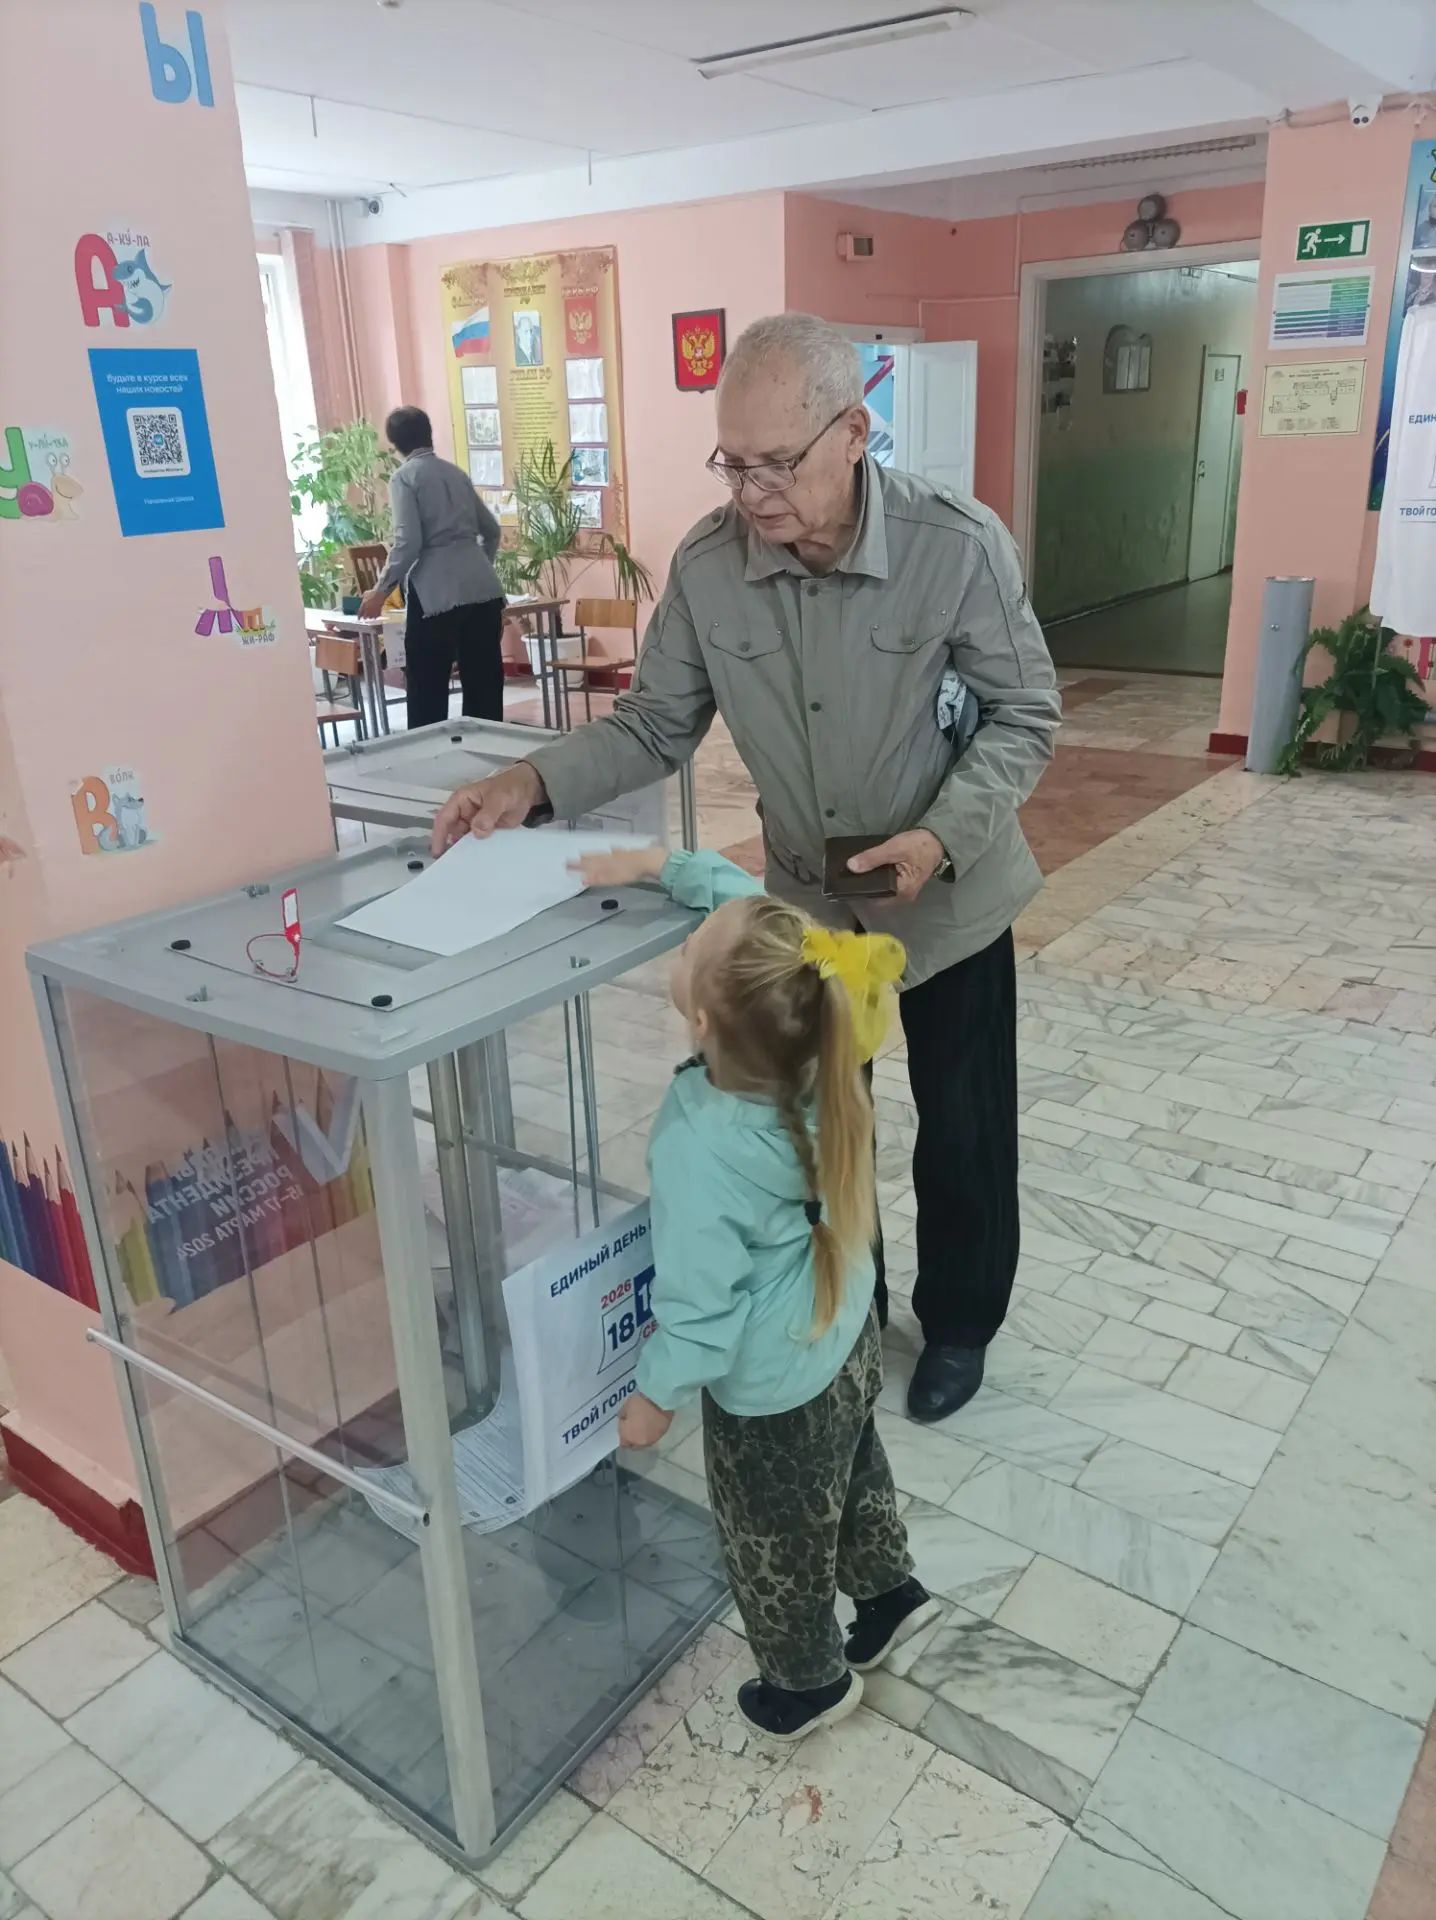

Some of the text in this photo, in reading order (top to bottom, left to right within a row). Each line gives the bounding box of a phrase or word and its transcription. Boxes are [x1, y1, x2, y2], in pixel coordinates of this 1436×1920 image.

[139, 1, 214, 107] Ы
[144, 384, 184, 393] новостей
[1408, 414, 1436, 425] ЕДИН
[1399, 505, 1425, 517] ТВОЙ
[550, 1223, 647, 1298] ЕДИНЫЙ ДЕНЬ
[600, 1279, 632, 1310] 2026
[607, 1311, 635, 1352] 18
[562, 1379, 637, 1445] ТВОЙ ГОЛО
